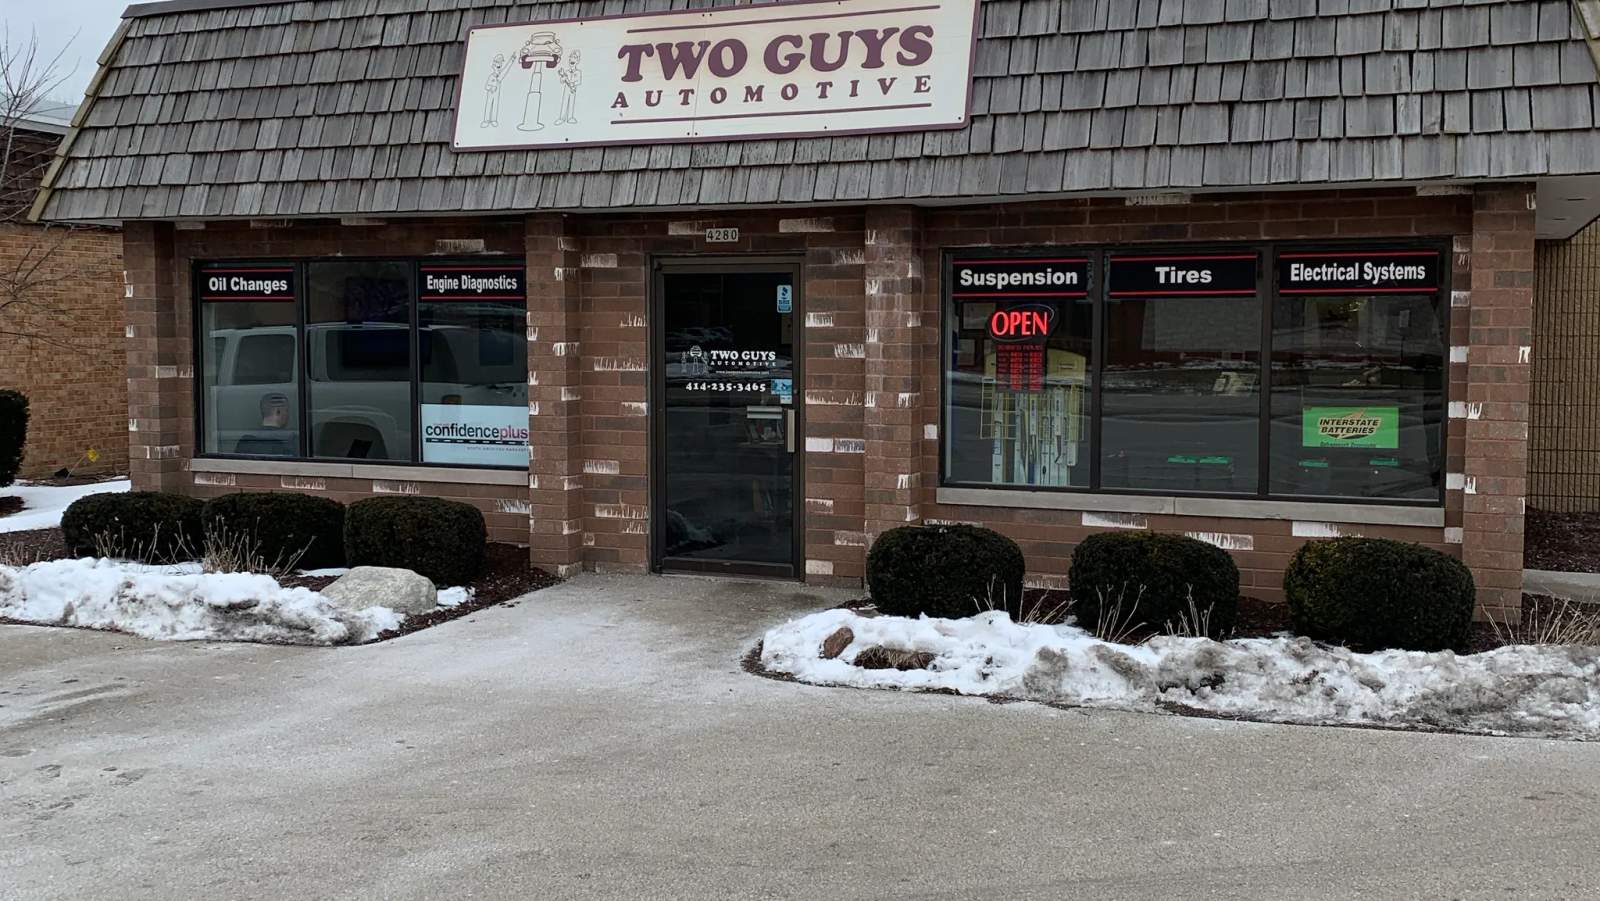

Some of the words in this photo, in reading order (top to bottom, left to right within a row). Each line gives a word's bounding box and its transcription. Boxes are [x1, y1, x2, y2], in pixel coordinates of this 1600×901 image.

[617, 38, 748, 83] TWO
[763, 25, 934, 76] GUYS
[611, 75, 931, 109] AUTOMOTIVE
[707, 230, 737, 240] 4280
[960, 268, 1078, 290] Suspension
[1155, 266, 1212, 284] Tires
[1290, 262, 1359, 281] Electrical
[1363, 262, 1426, 285] Systems
[209, 277, 226, 291] Oil
[230, 277, 288, 294] Changes
[426, 275, 459, 293] Engine
[461, 275, 517, 293] Diagnostics
[991, 311, 1048, 336] OPEN
[710, 350, 739, 360] TWO
[741, 351, 776, 361] GUYS
[425, 423, 528, 440] confidenceplus
[1321, 426, 1375, 434] BATTERIES
